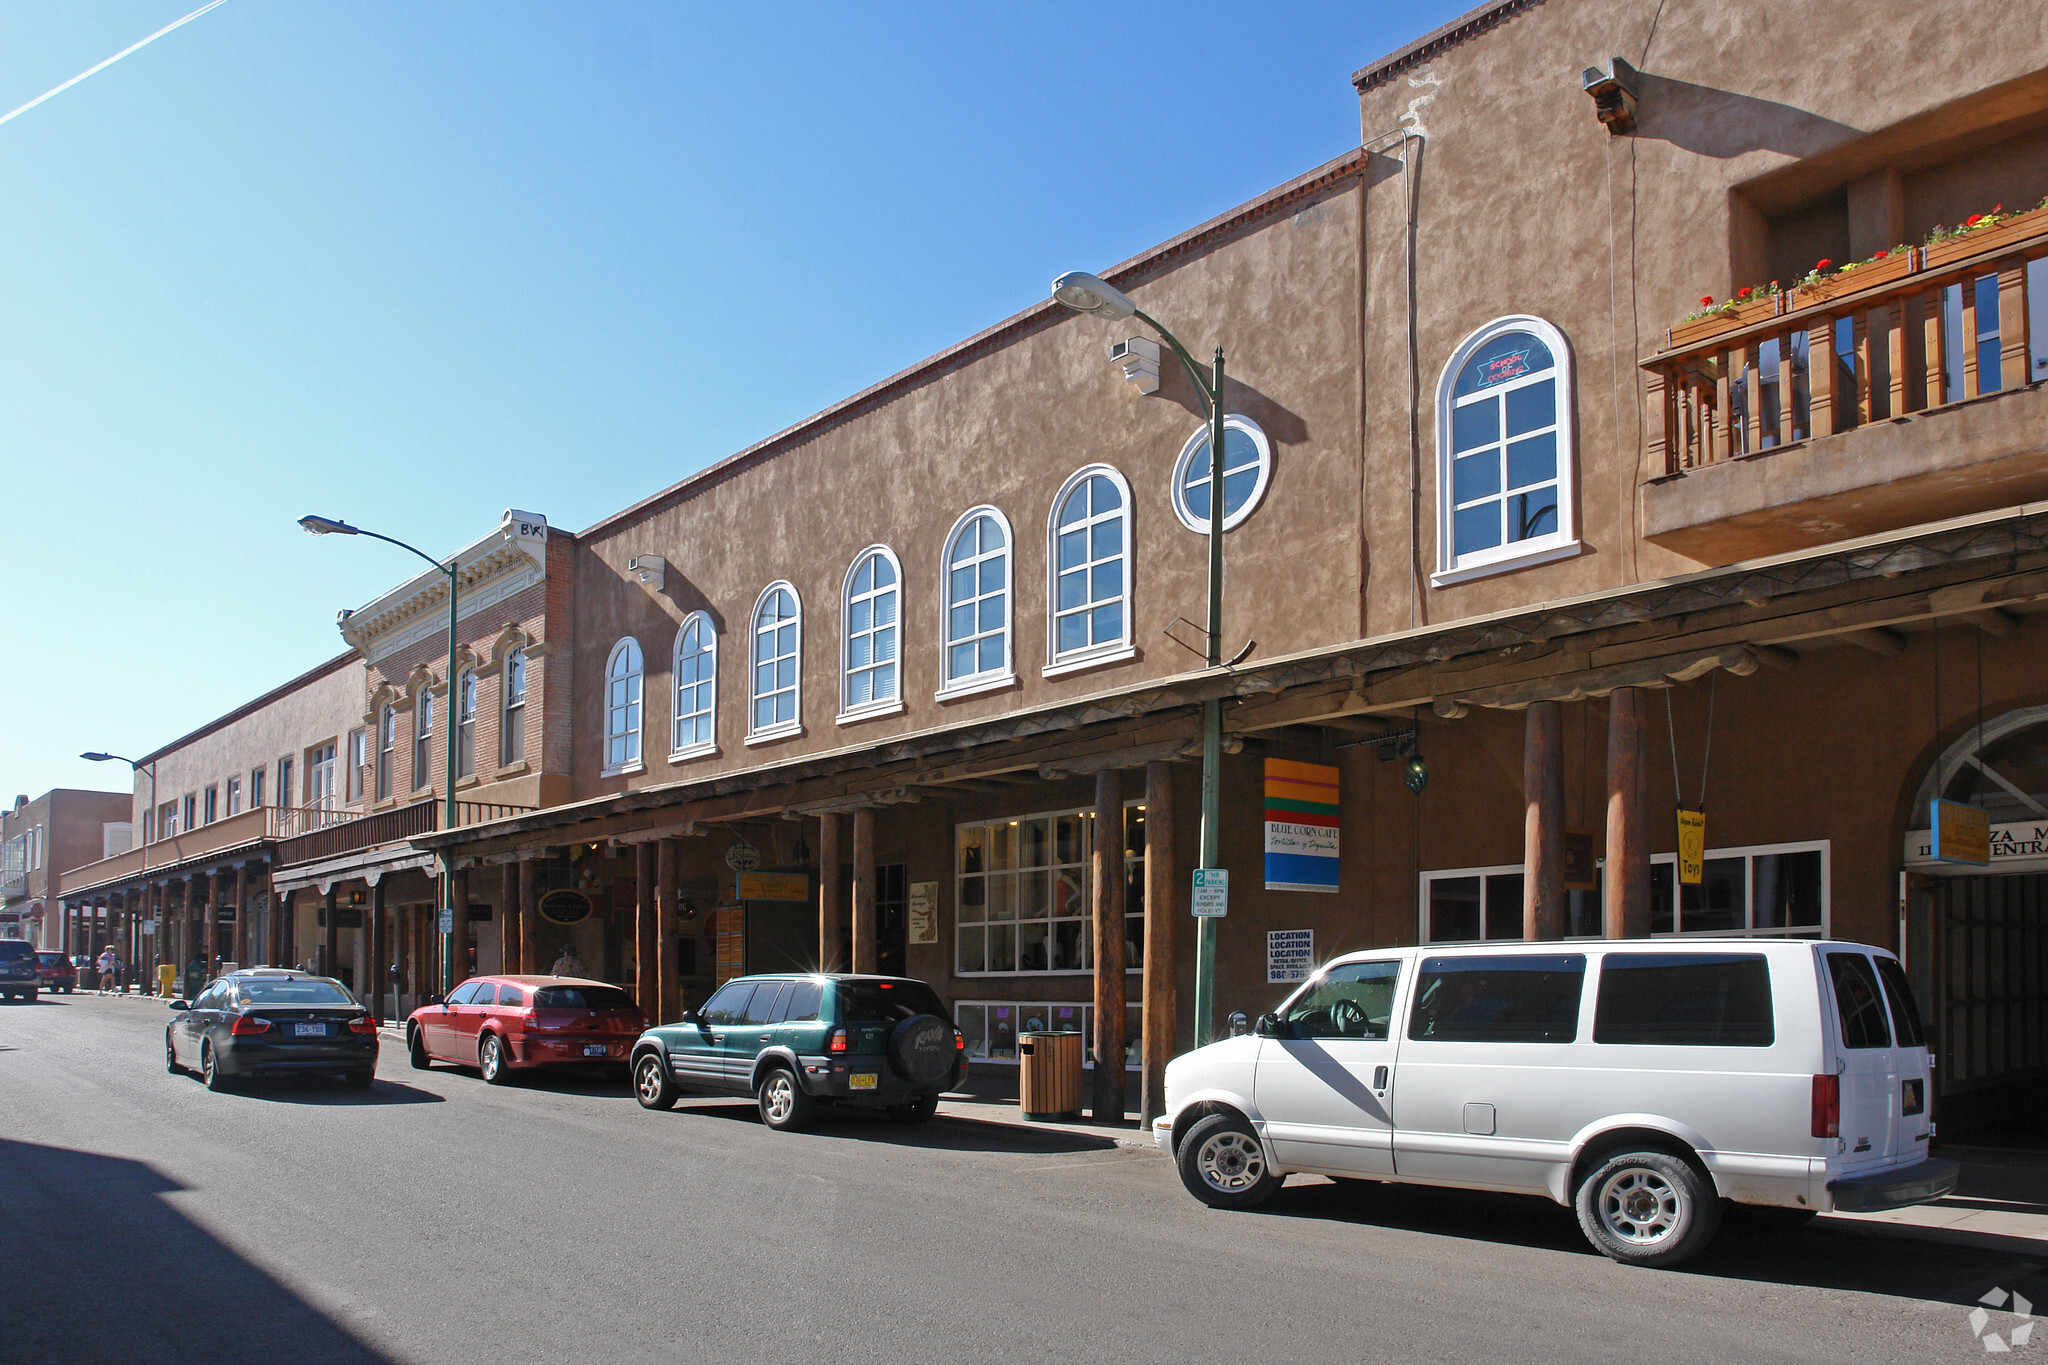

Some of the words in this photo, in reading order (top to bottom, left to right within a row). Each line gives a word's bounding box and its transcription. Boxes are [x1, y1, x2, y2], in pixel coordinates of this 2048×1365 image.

[1489, 354, 1522, 371] SCHOOL
[1501, 362, 1514, 373] OF
[1488, 364, 1524, 382] COOKING
[1271, 823, 1293, 835] BLUE
[1293, 825, 1317, 837] CORN
[1683, 859, 1700, 878] Toys
[1196, 872, 1204, 885] 2
[1270, 931, 1310, 941] LOCATION
[1270, 940, 1310, 949] LOCATION
[1270, 949, 1310, 958] LOCATION
